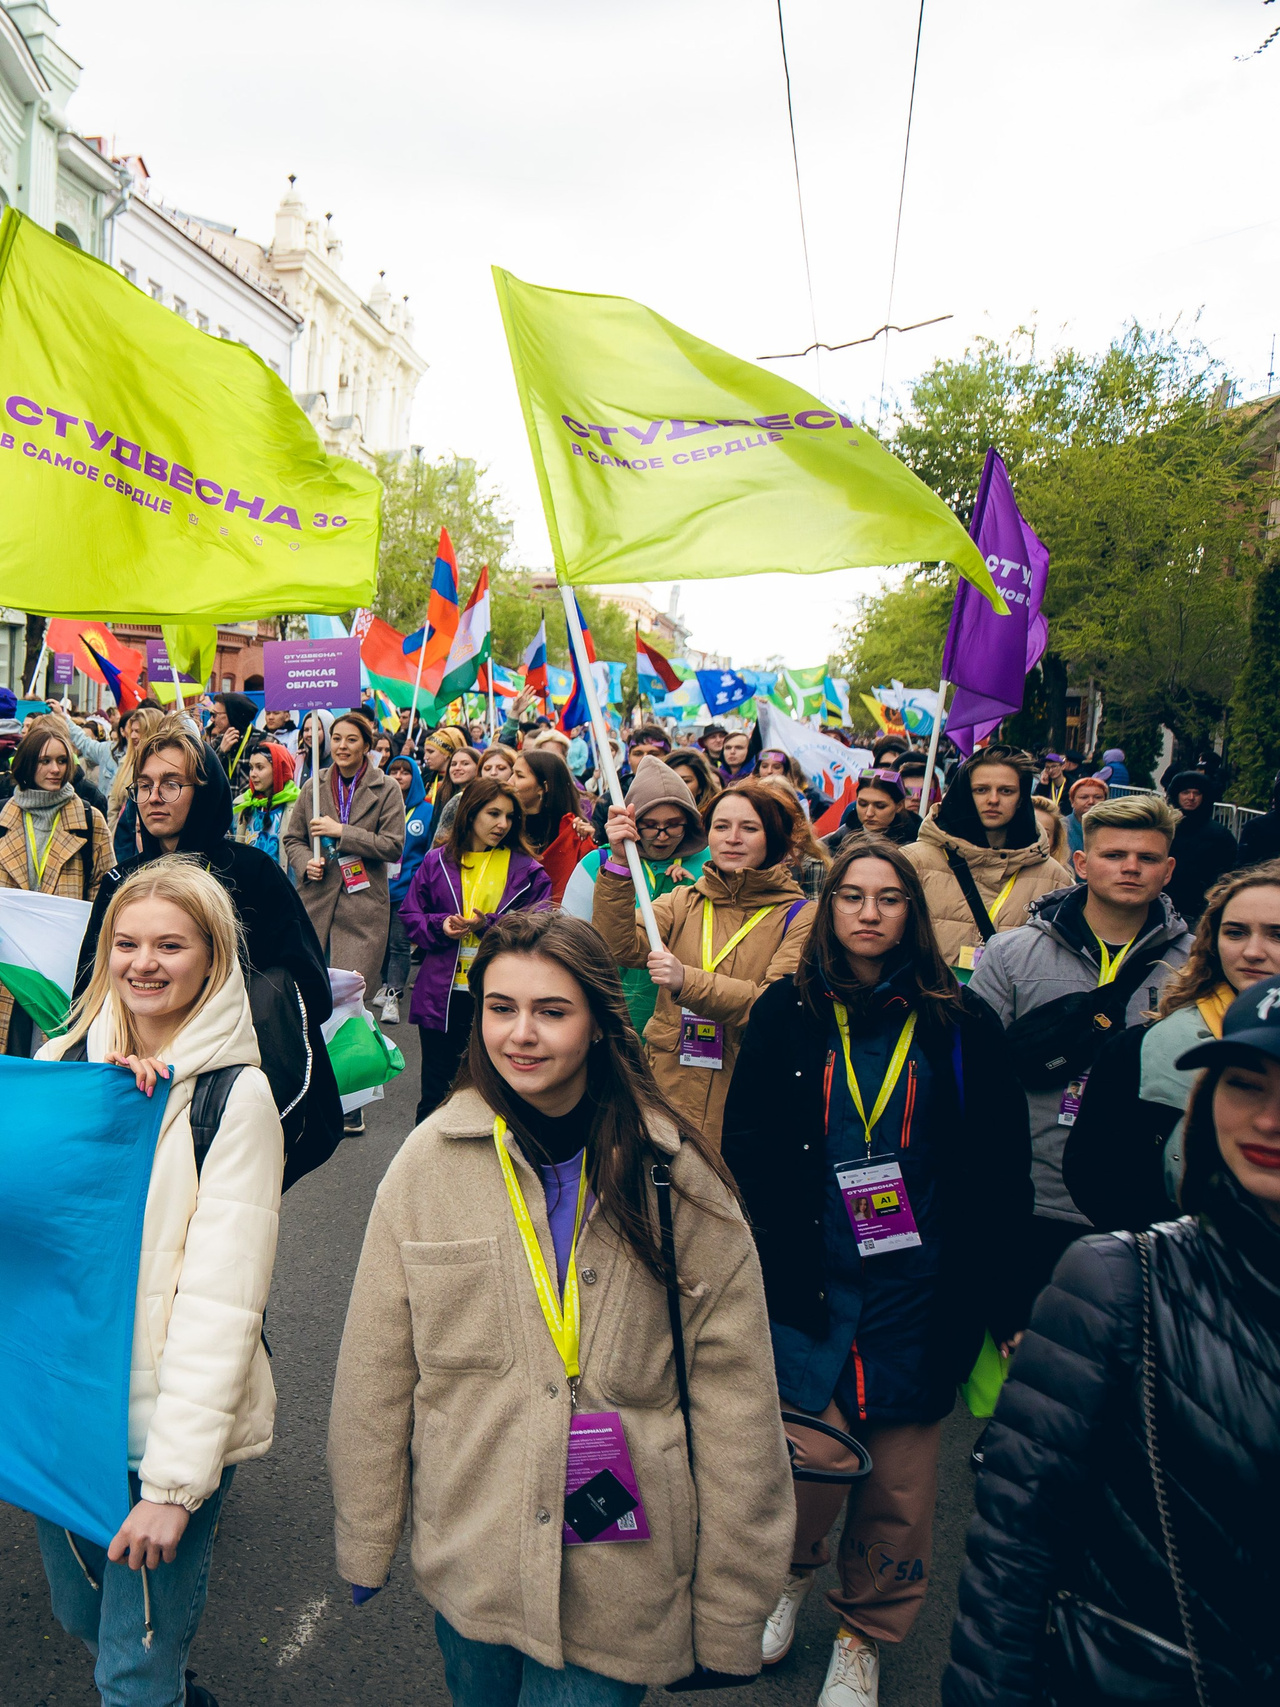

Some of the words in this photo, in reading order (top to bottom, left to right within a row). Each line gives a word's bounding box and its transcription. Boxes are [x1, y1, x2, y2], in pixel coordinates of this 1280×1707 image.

[5, 395, 302, 530] СТУДВЕСНА
[312, 512, 347, 528] 30
[572, 442, 584, 456] В
[588, 449, 664, 470] САМОЕ
[672, 431, 784, 466] СЕРДЦЕ
[0, 432, 15, 449] В
[22, 441, 100, 482] САМОЕ
[103, 472, 172, 515] СЕРДЦЕ
[286, 680, 339, 690] ОБЛАСТЬ
[288, 668, 336, 678] ОМСКАЯ
[881, 1197, 891, 1205] A1
